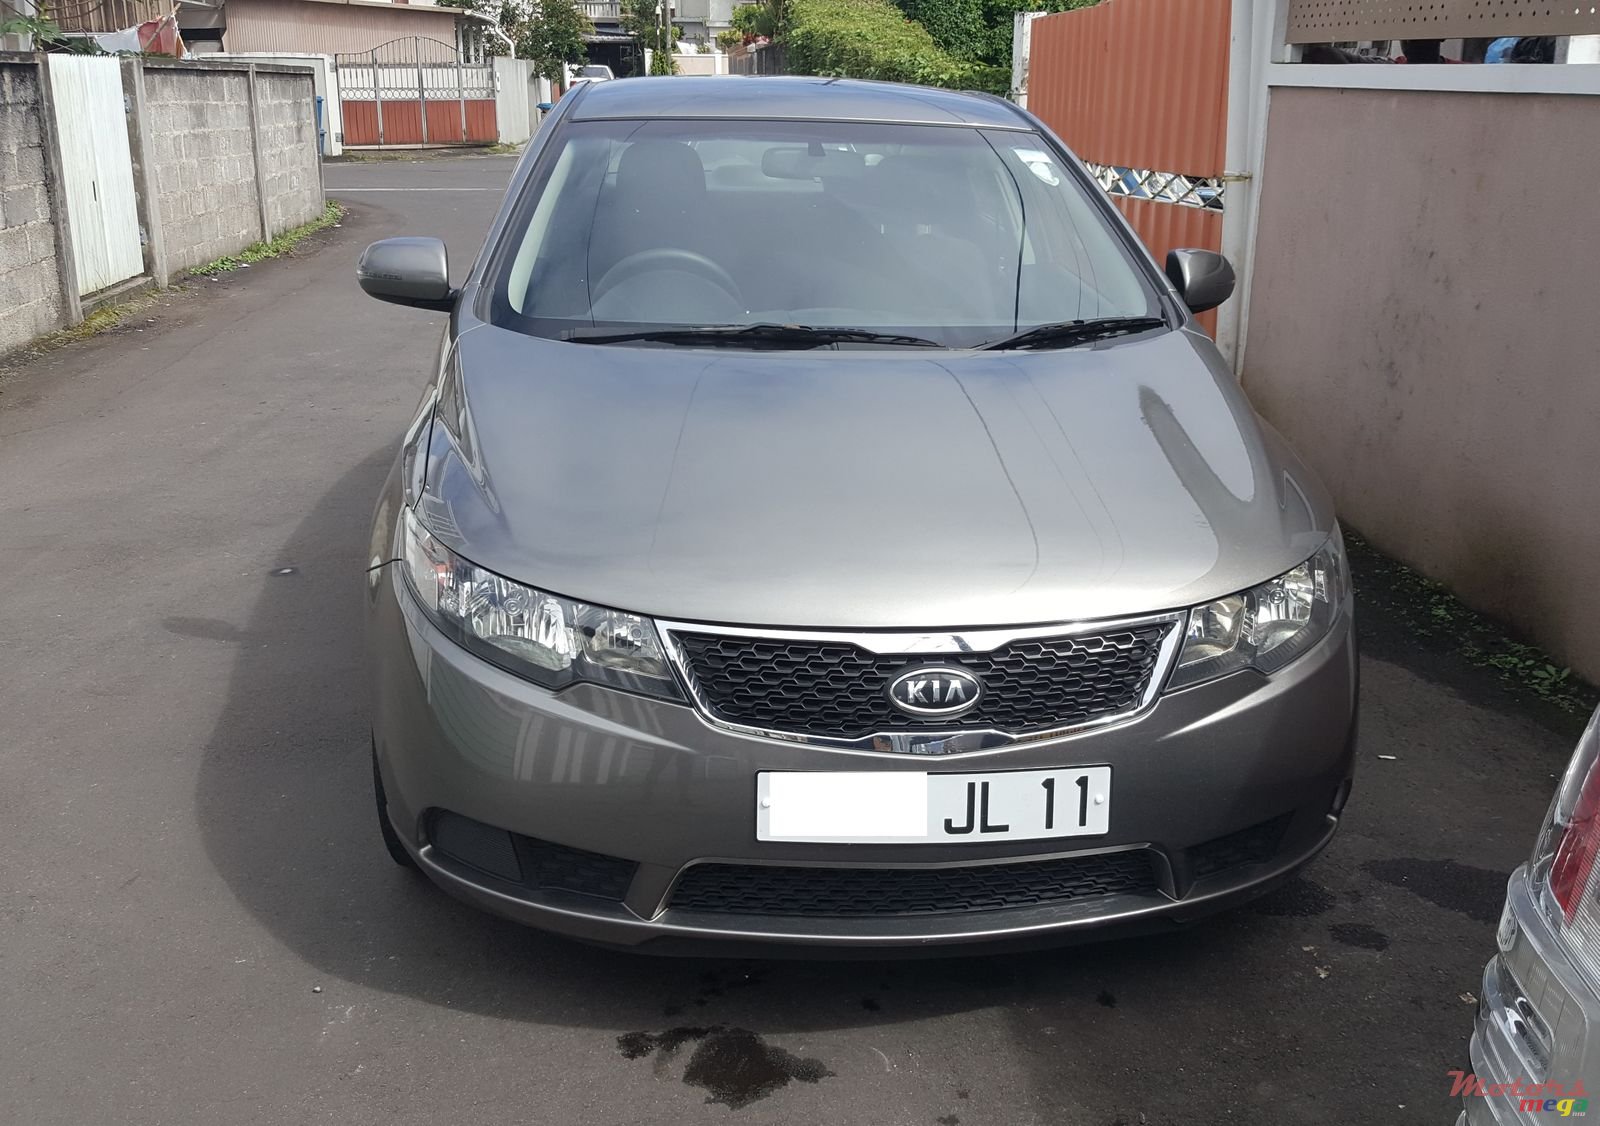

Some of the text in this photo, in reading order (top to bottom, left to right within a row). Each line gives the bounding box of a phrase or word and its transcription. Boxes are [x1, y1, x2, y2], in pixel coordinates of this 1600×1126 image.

[906, 679, 966, 704] KIA
[943, 775, 1089, 835] JL 11
